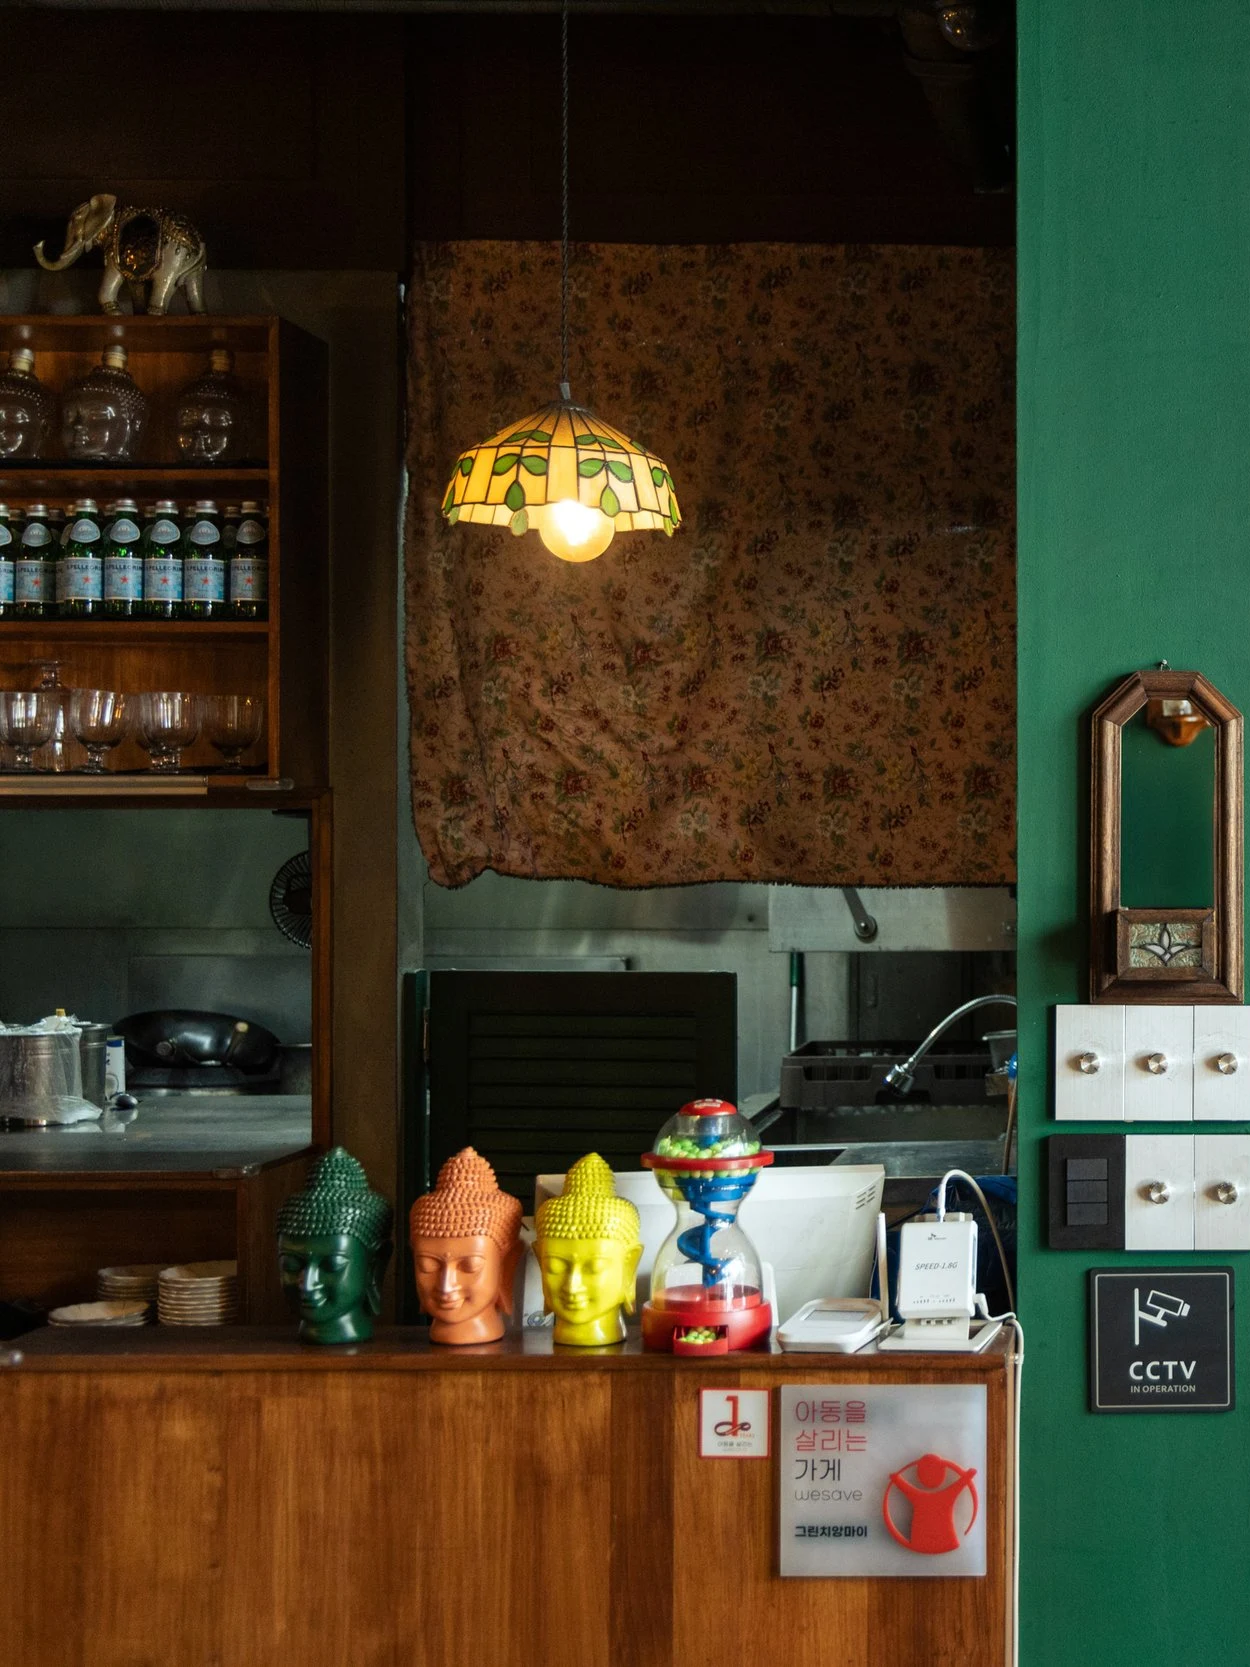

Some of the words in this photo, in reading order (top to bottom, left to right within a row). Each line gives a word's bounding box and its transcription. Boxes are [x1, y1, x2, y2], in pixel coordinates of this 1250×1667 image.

[914, 1261, 959, 1271] SPEED-1.8G
[1128, 1360, 1197, 1380] CCTV
[1130, 1385, 1141, 1393] IN
[1142, 1384, 1196, 1393] OPERATION
[795, 1400, 867, 1423] 아동을
[795, 1429, 867, 1452] 살리는
[795, 1458, 841, 1481] 가게
[794, 1488, 864, 1501] wesave
[794, 1525, 868, 1538] 그린치앙마이
